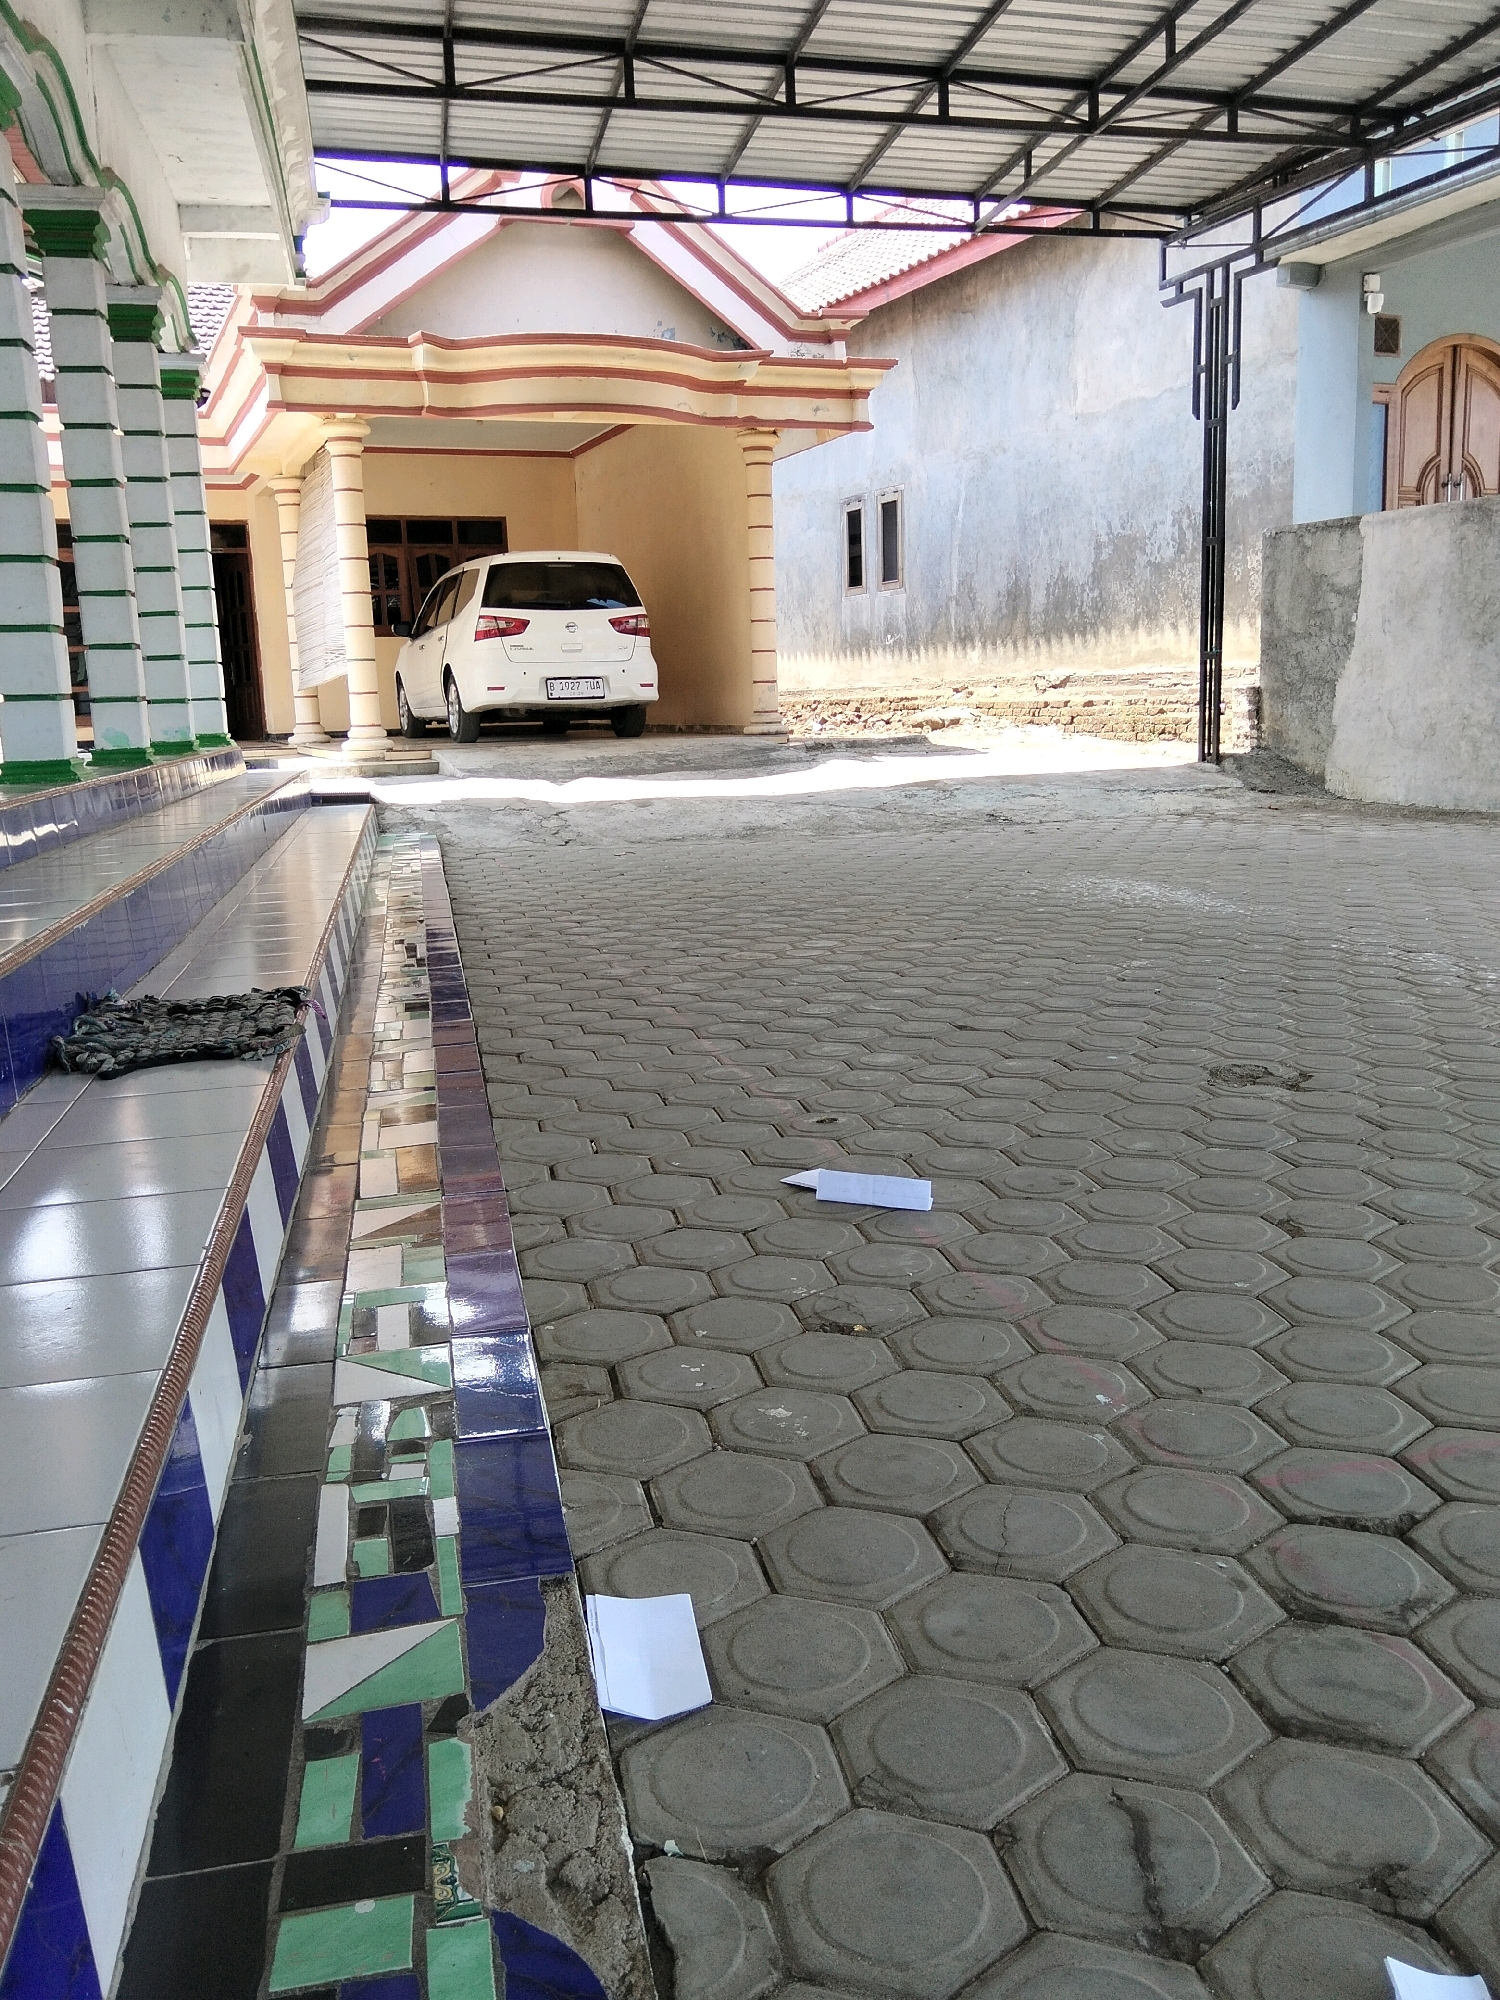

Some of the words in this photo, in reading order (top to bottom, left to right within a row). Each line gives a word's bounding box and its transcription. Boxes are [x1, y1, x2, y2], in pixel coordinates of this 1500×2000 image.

[550, 682, 555, 691] B
[560, 681, 580, 691] 1927
[585, 681, 601, 690] TUA
